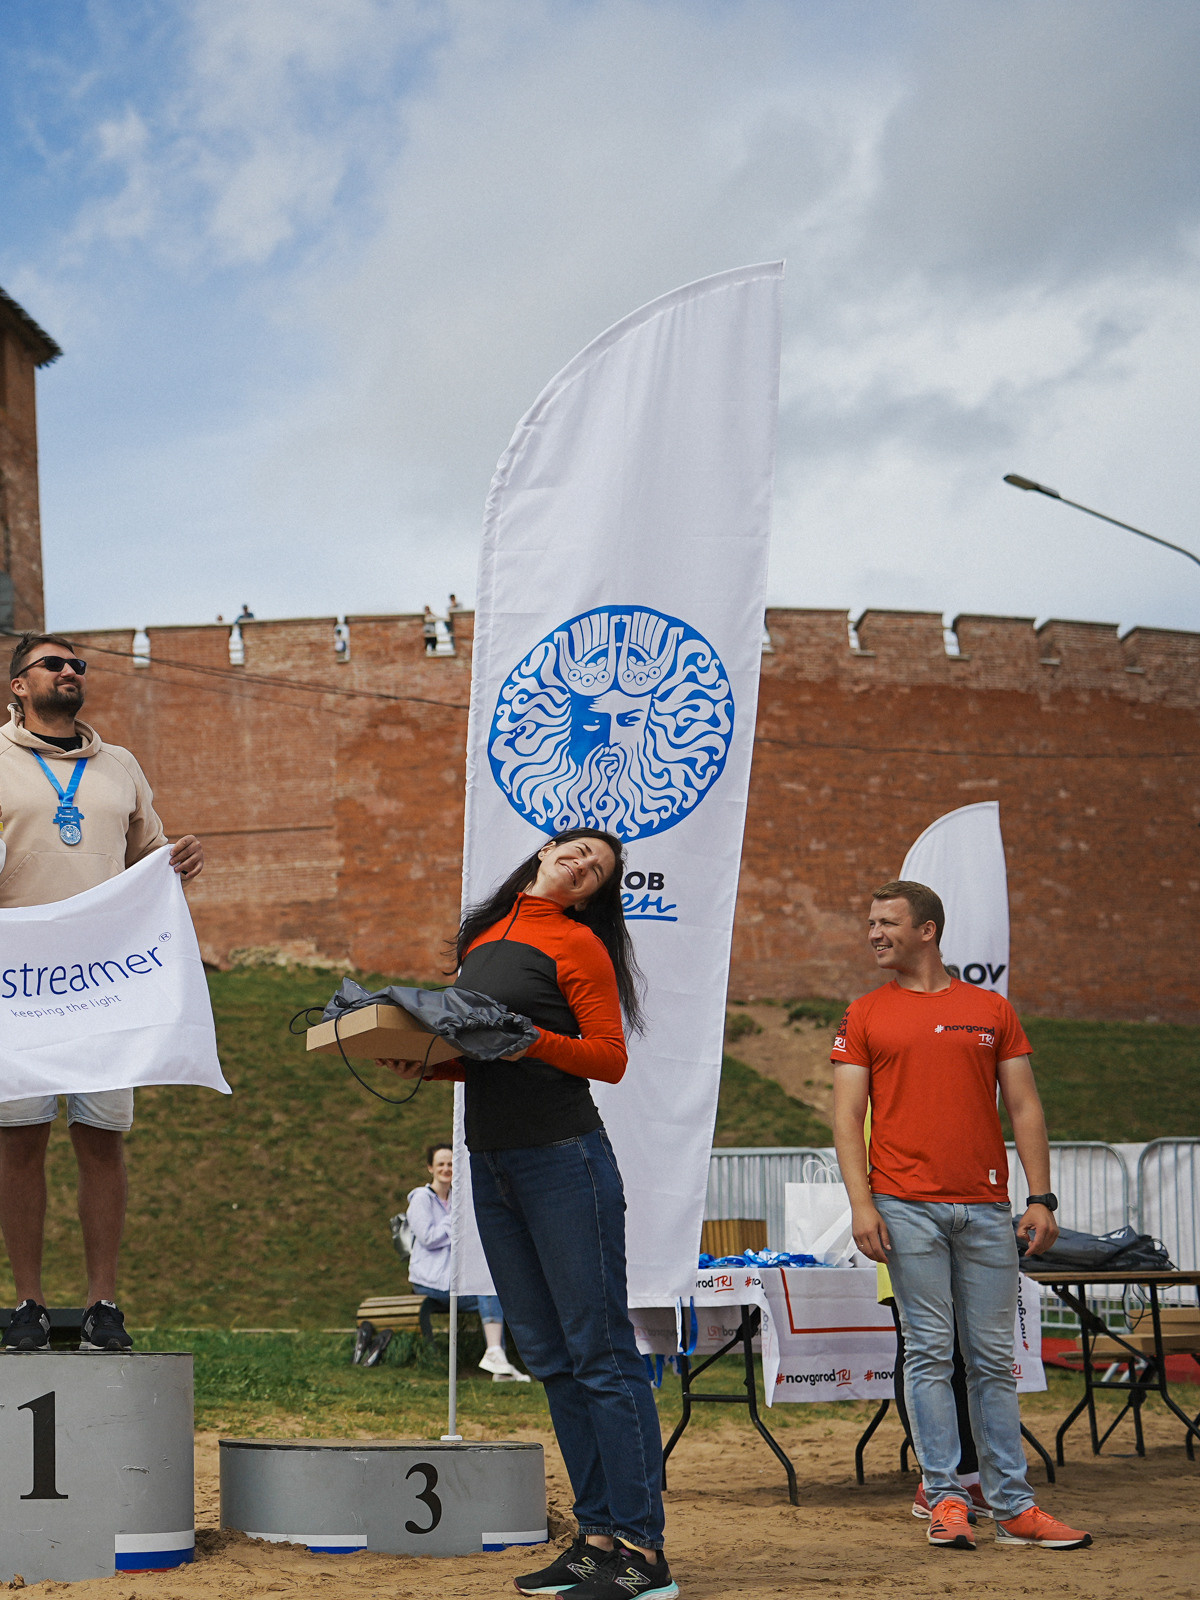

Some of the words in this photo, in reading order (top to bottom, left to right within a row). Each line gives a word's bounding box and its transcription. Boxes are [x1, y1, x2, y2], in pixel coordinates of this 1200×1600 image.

[11, 1006, 65, 1018] keeping
[66, 1003, 88, 1013] the
[91, 994, 122, 1008] light
[934, 1024, 995, 1035] #novgorod
[17, 1390, 69, 1500] 1
[404, 1462, 443, 1535] 3
